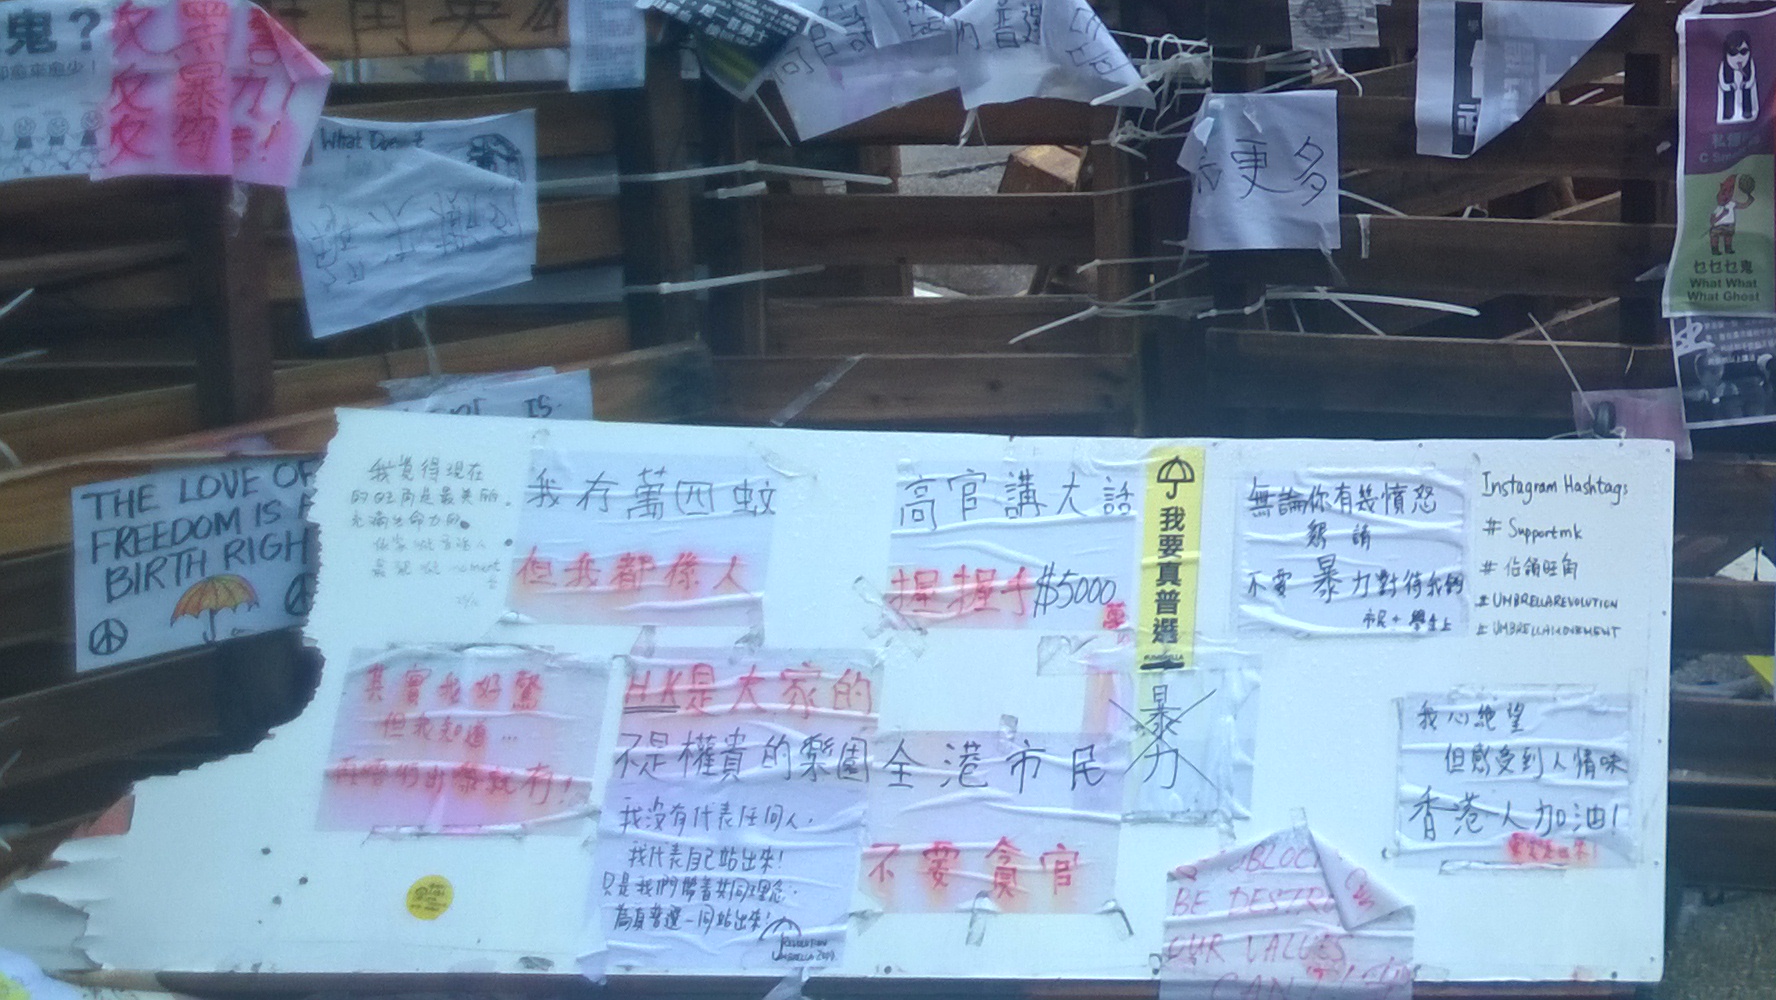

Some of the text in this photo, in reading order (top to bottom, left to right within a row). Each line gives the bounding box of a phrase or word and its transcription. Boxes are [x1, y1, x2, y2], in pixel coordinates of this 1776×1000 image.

[1687, 291, 1760, 303] What Ghost
[1689, 278, 1758, 290] What What
[81, 484, 160, 521] THE
[179, 469, 259, 503] LOVE
[900, 468, 1135, 531] 高官講大話
[1482, 471, 1628, 506] Instagram Hashtags
[91, 500, 282, 565] FREEDOM IS
[1482, 516, 1502, 536] #
[106, 547, 207, 604] BIRTH
[1152, 506, 1187, 644] 我要真普選
[883, 738, 1106, 795] 全港市民
[1408, 784, 1620, 842] 香港人加油!
